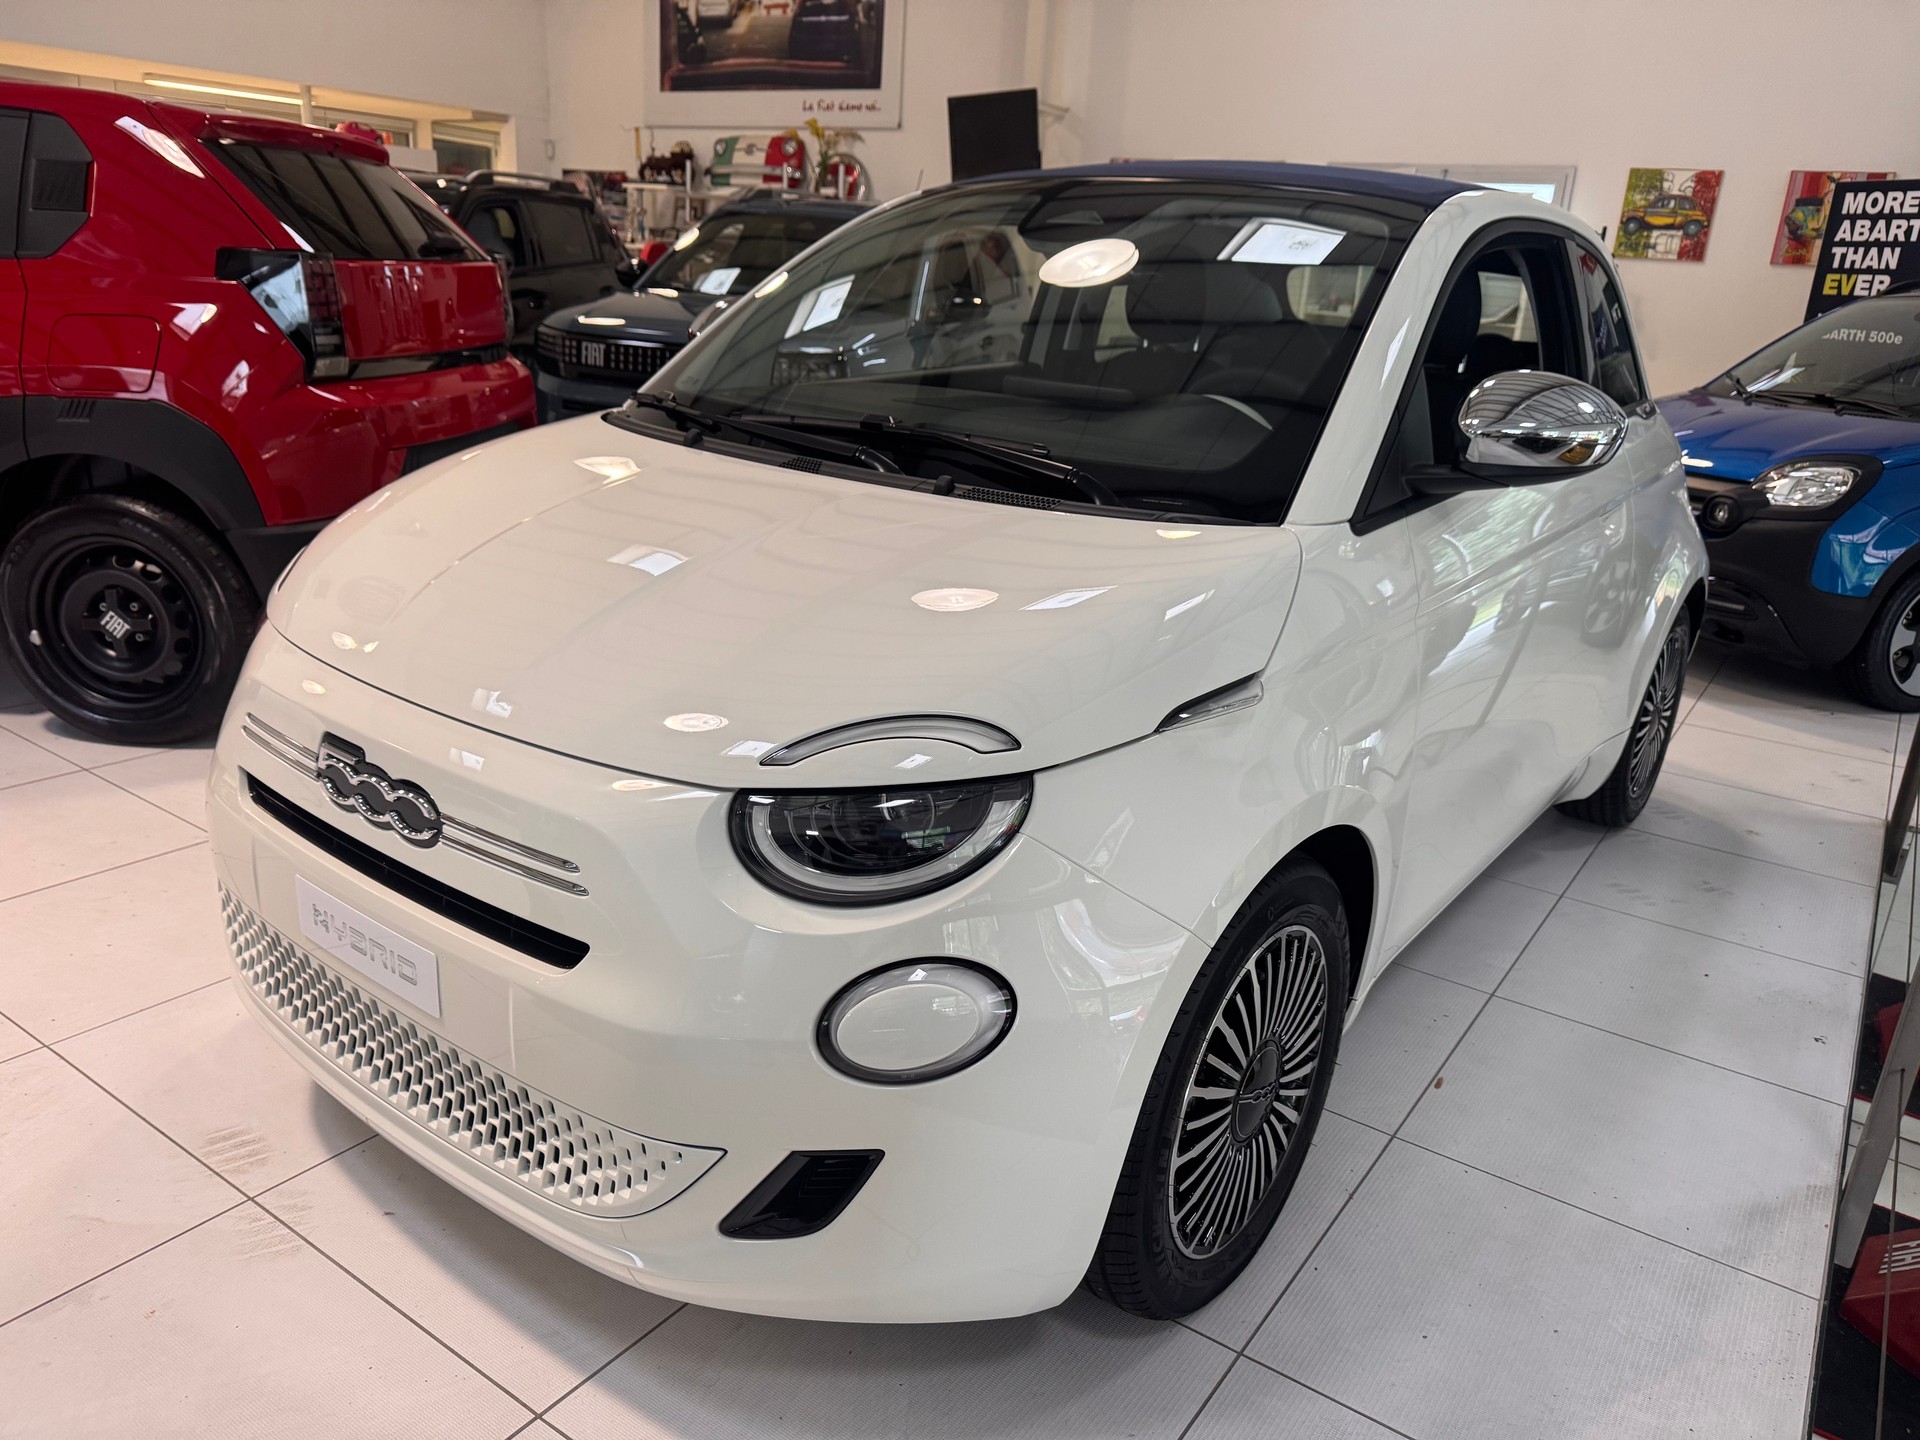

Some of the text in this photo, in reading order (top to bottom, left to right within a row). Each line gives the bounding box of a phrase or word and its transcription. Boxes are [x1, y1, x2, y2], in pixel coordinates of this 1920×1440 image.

[1841, 191, 1920, 215] MORE
[1831, 247, 1901, 269] THAN
[1822, 274, 1891, 296] EVER
[1822, 328, 1903, 344] ARTH 500e
[581, 341, 607, 367] FIAT
[100, 610, 131, 639] FIAT
[316, 731, 442, 848] 500
[311, 902, 418, 986] HYBRID
